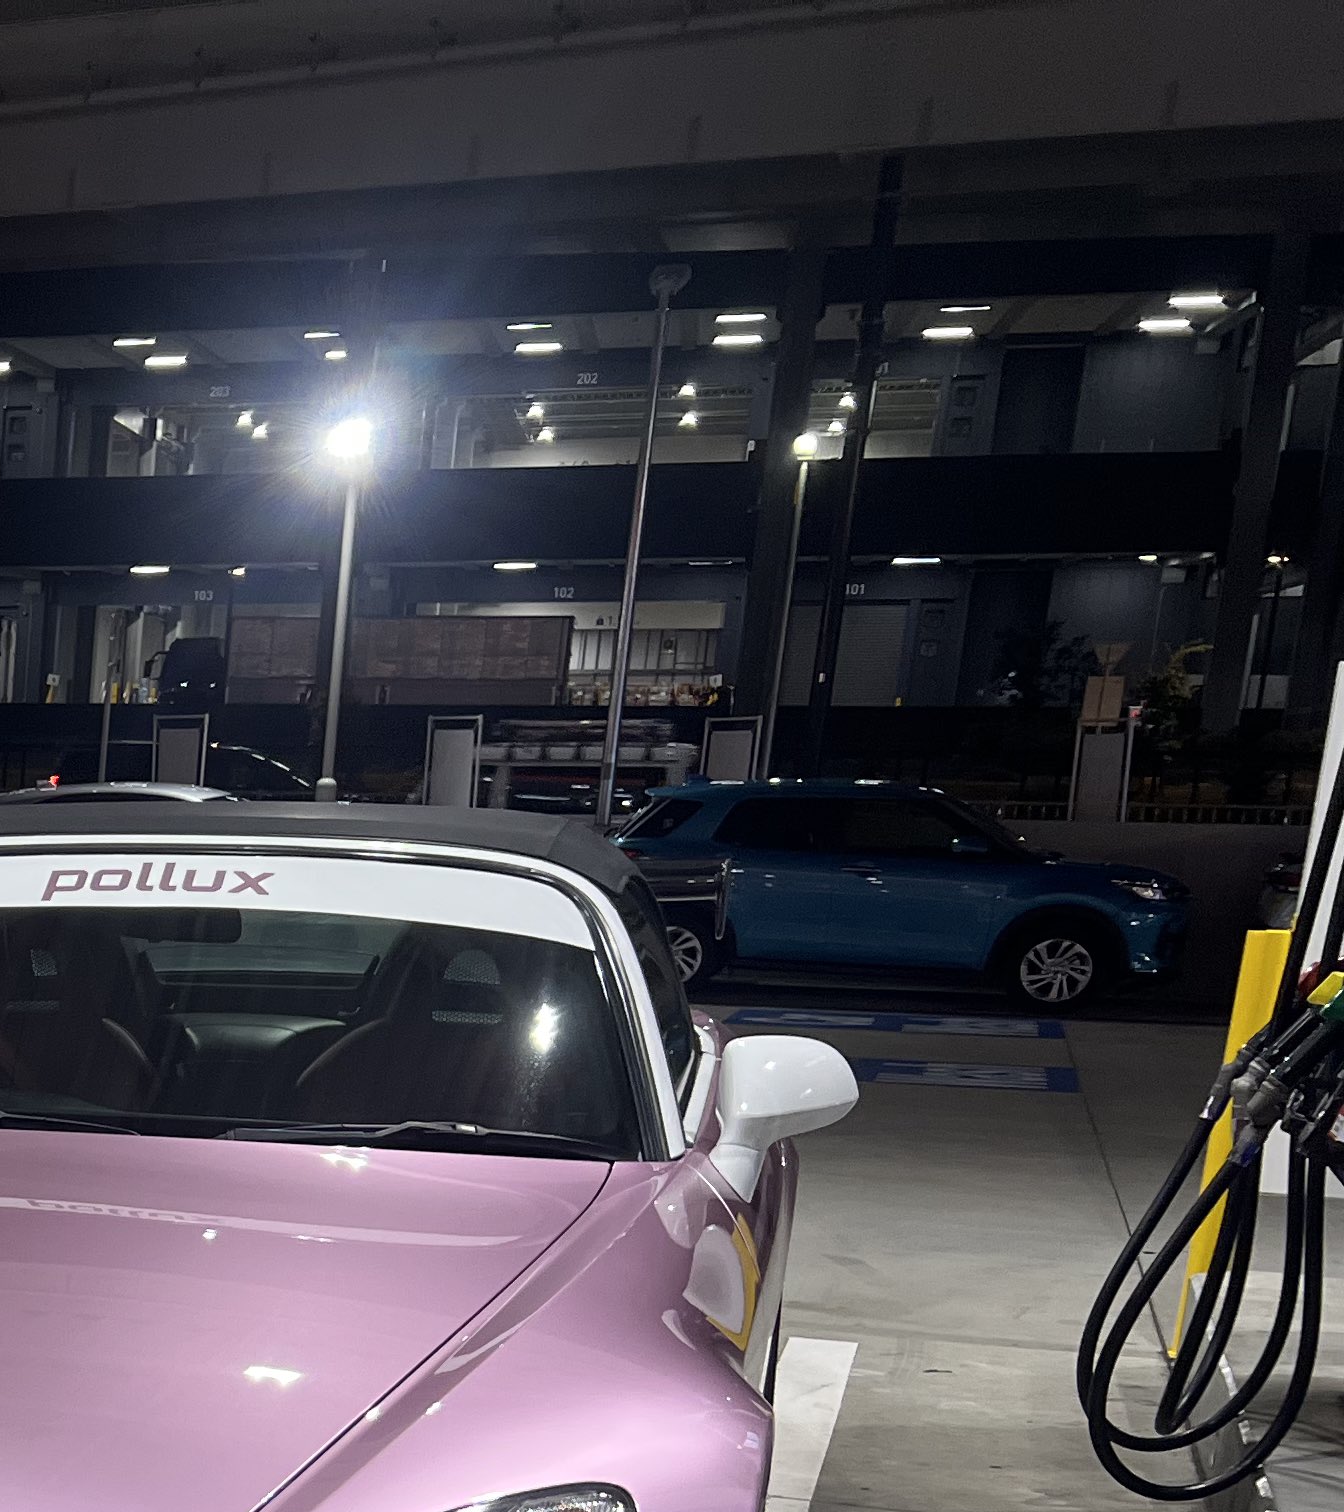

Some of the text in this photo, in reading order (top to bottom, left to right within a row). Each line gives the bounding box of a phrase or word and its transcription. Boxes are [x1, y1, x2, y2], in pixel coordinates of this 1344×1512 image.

[576, 372, 598, 385] 202
[553, 587, 574, 599] 102
[845, 583, 865, 595] 101
[193, 590, 214, 601] 103
[41, 862, 275, 902] pollux
